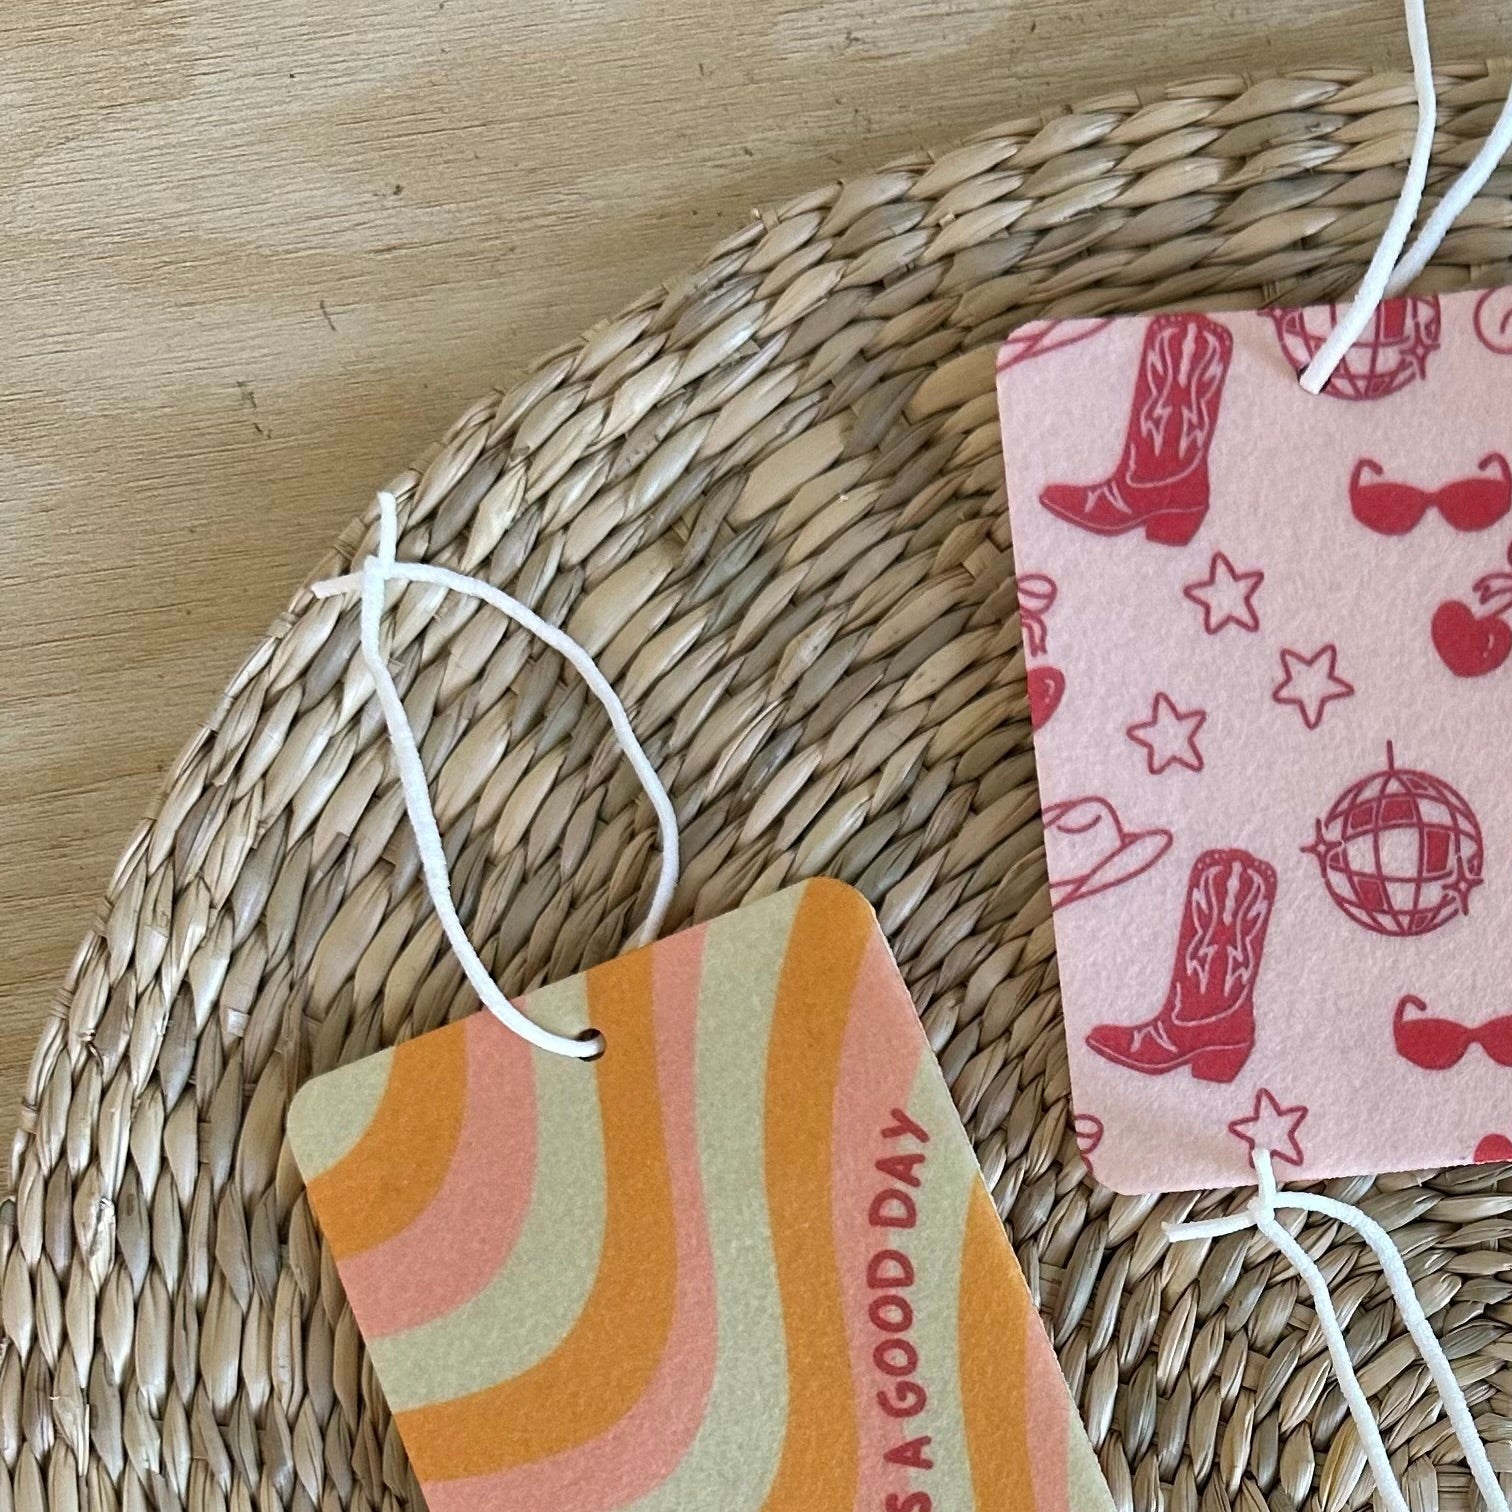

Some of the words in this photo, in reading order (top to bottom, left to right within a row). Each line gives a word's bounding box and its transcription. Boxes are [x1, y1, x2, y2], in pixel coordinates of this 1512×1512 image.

[869, 1108, 930, 1230] DAY
[866, 1248, 927, 1418] GOOD
[884, 1435, 932, 1470] A
